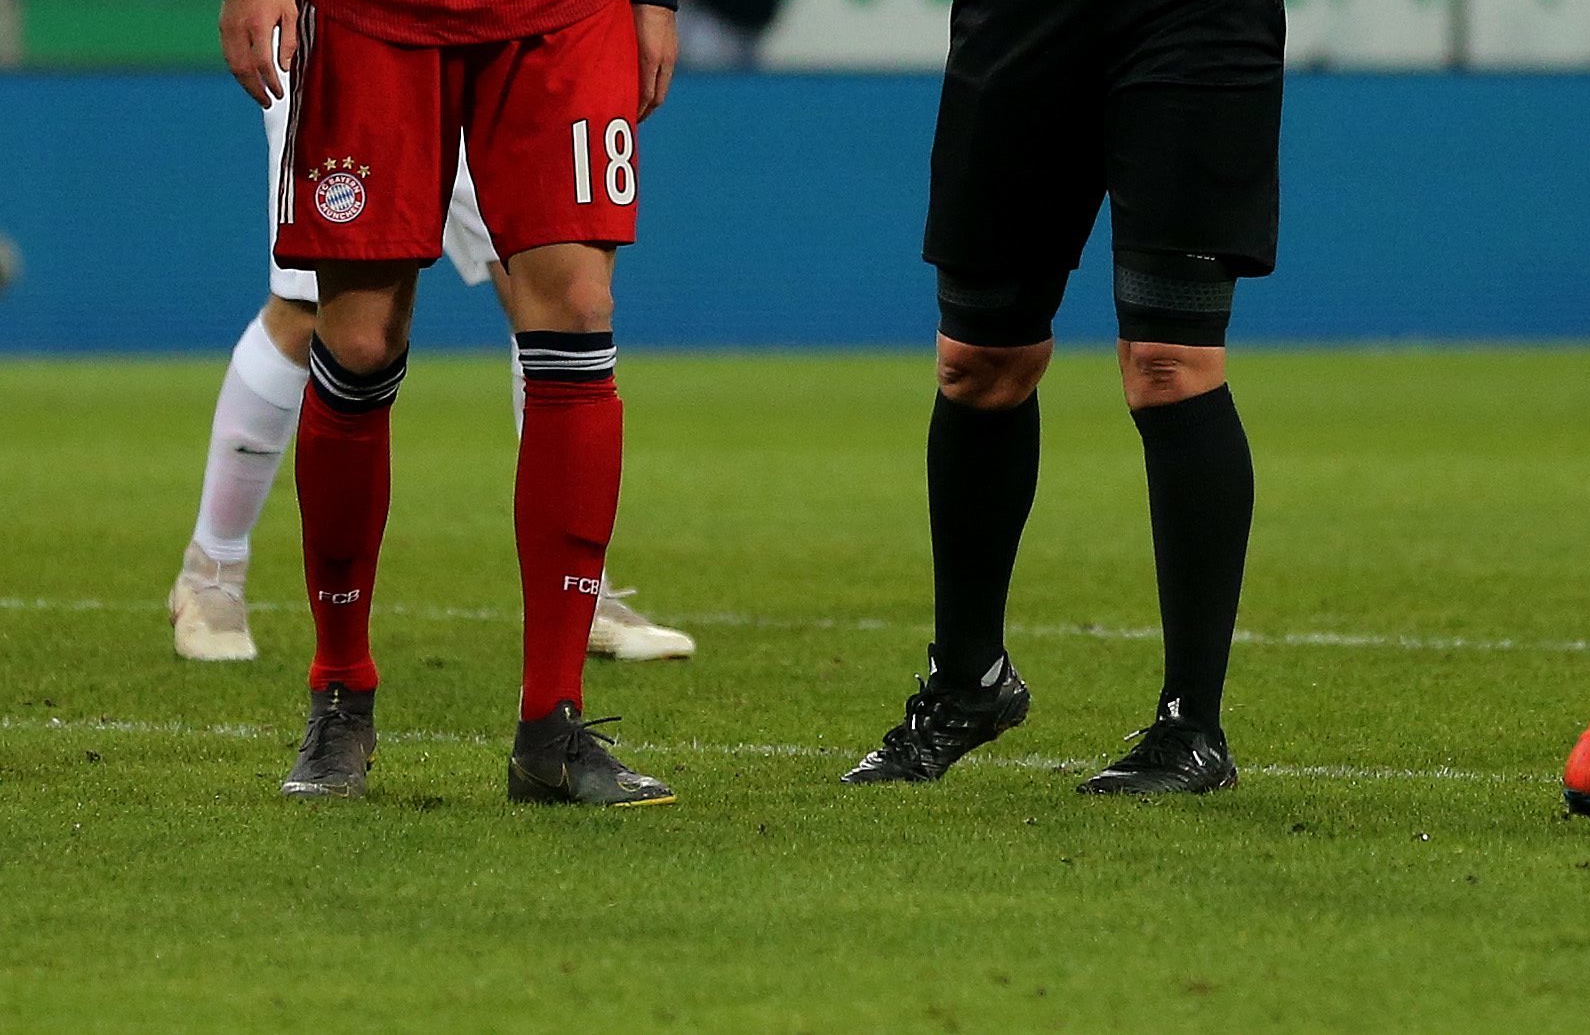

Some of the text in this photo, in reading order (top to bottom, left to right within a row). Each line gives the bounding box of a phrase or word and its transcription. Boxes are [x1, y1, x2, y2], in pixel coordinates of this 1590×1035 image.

[572, 118, 637, 205] 18
[328, 175, 361, 194] BAYERN
[563, 575, 600, 595] FCB
[318, 589, 360, 604] FCB
